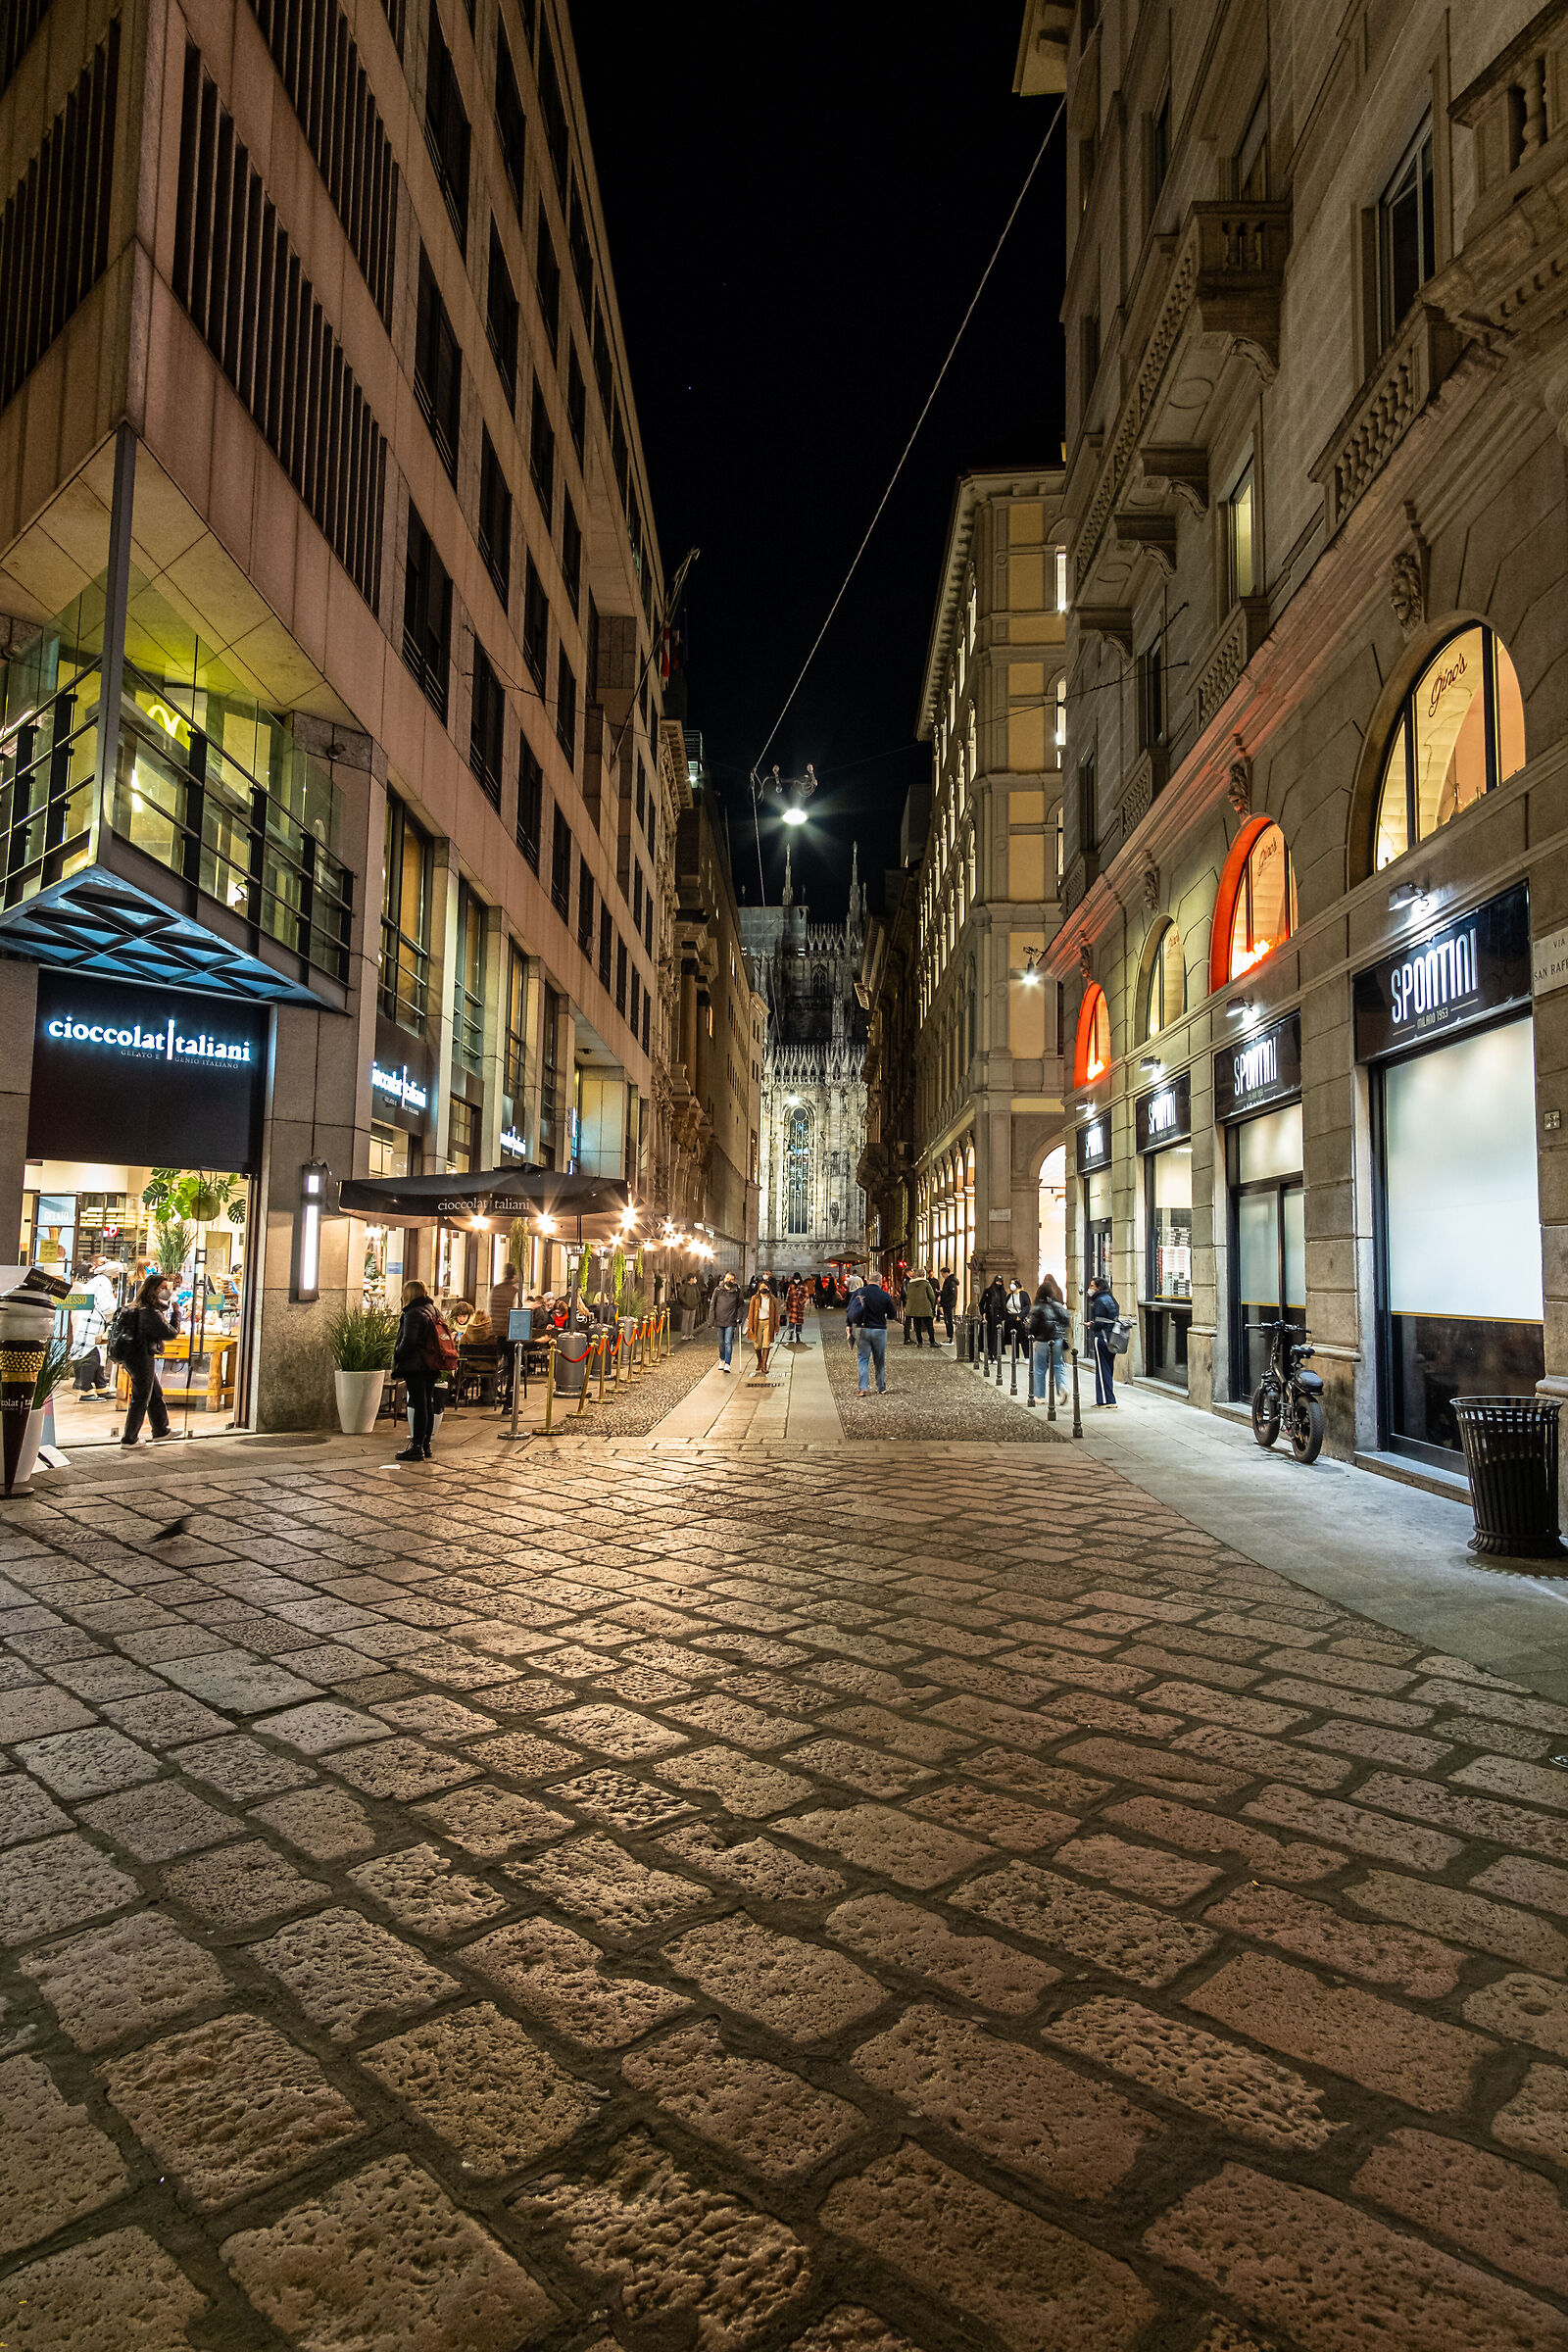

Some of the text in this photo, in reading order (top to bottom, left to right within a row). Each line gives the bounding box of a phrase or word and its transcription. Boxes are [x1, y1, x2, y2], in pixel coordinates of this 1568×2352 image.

[1552, 938, 1565, 949] VIA
[1391, 927, 1479, 1024] SPONTINI
[1533, 966, 1547, 982] SAN
[120, 1049, 153, 1059] GELATO
[174, 1055, 200, 1065] GENIO
[201, 1059, 239, 1070] ITALIANO
[1234, 1036, 1277, 1097] SPONTINI
